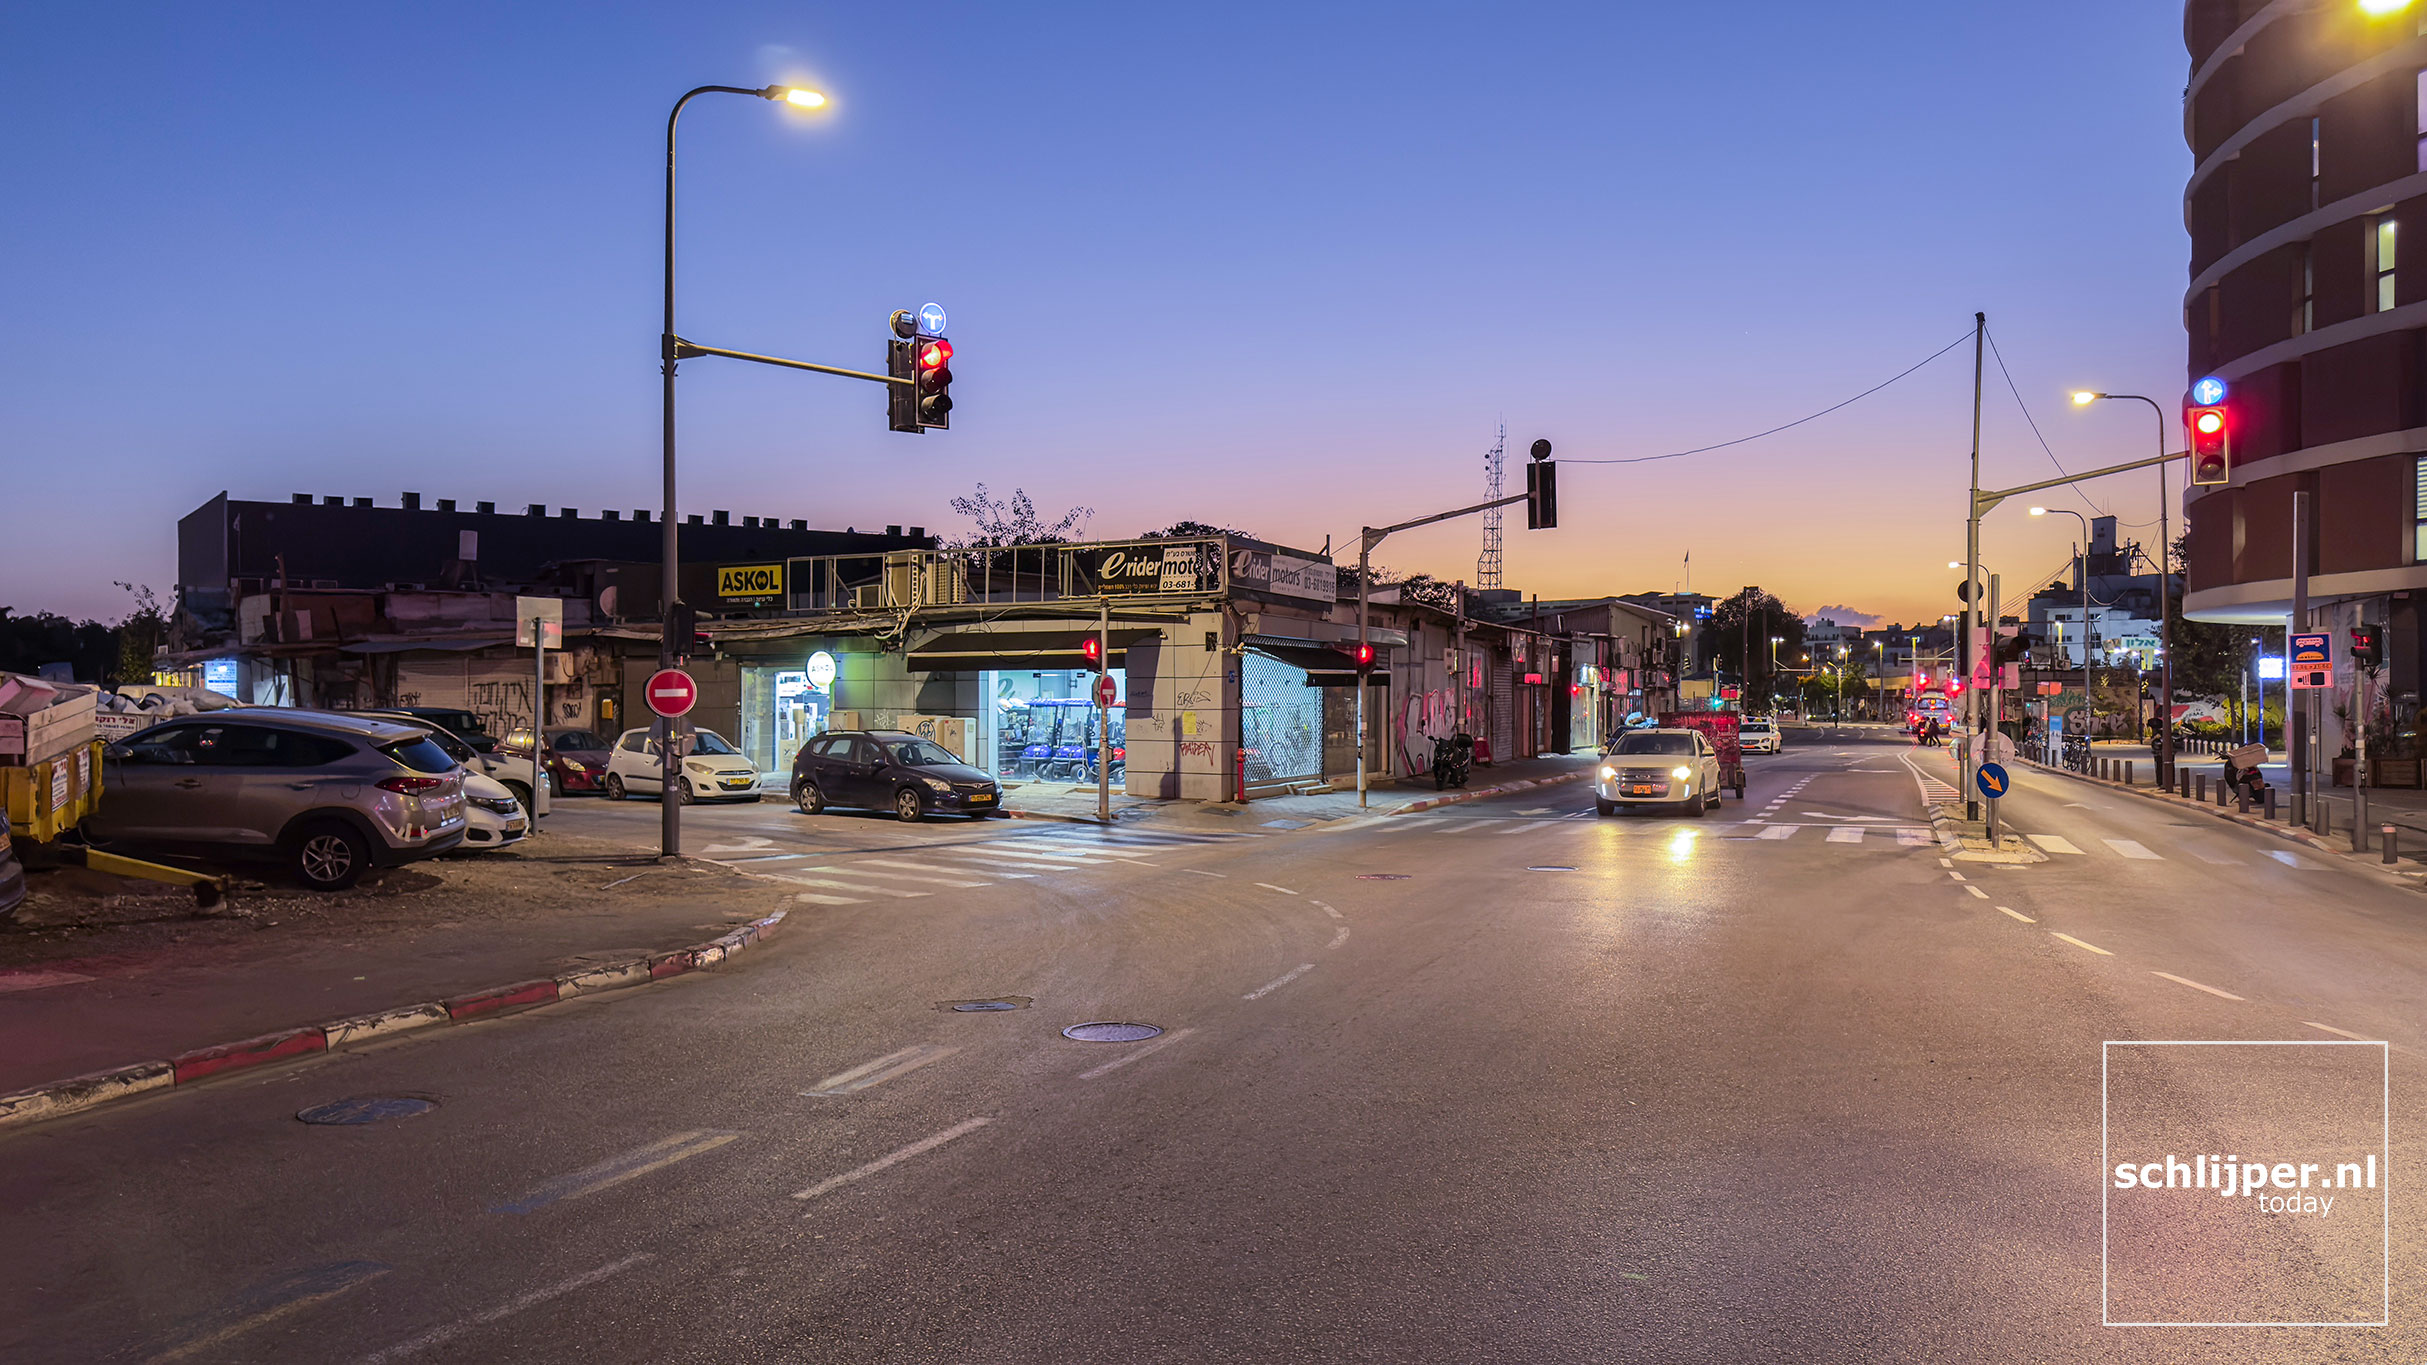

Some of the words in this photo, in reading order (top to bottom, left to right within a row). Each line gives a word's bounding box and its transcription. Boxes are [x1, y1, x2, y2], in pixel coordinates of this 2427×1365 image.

[721, 570, 779, 592] ASKOL
[1272, 566, 1301, 586] motors
[2126, 638, 2156, 648] אלון
[119, 716, 136, 724] אלי
